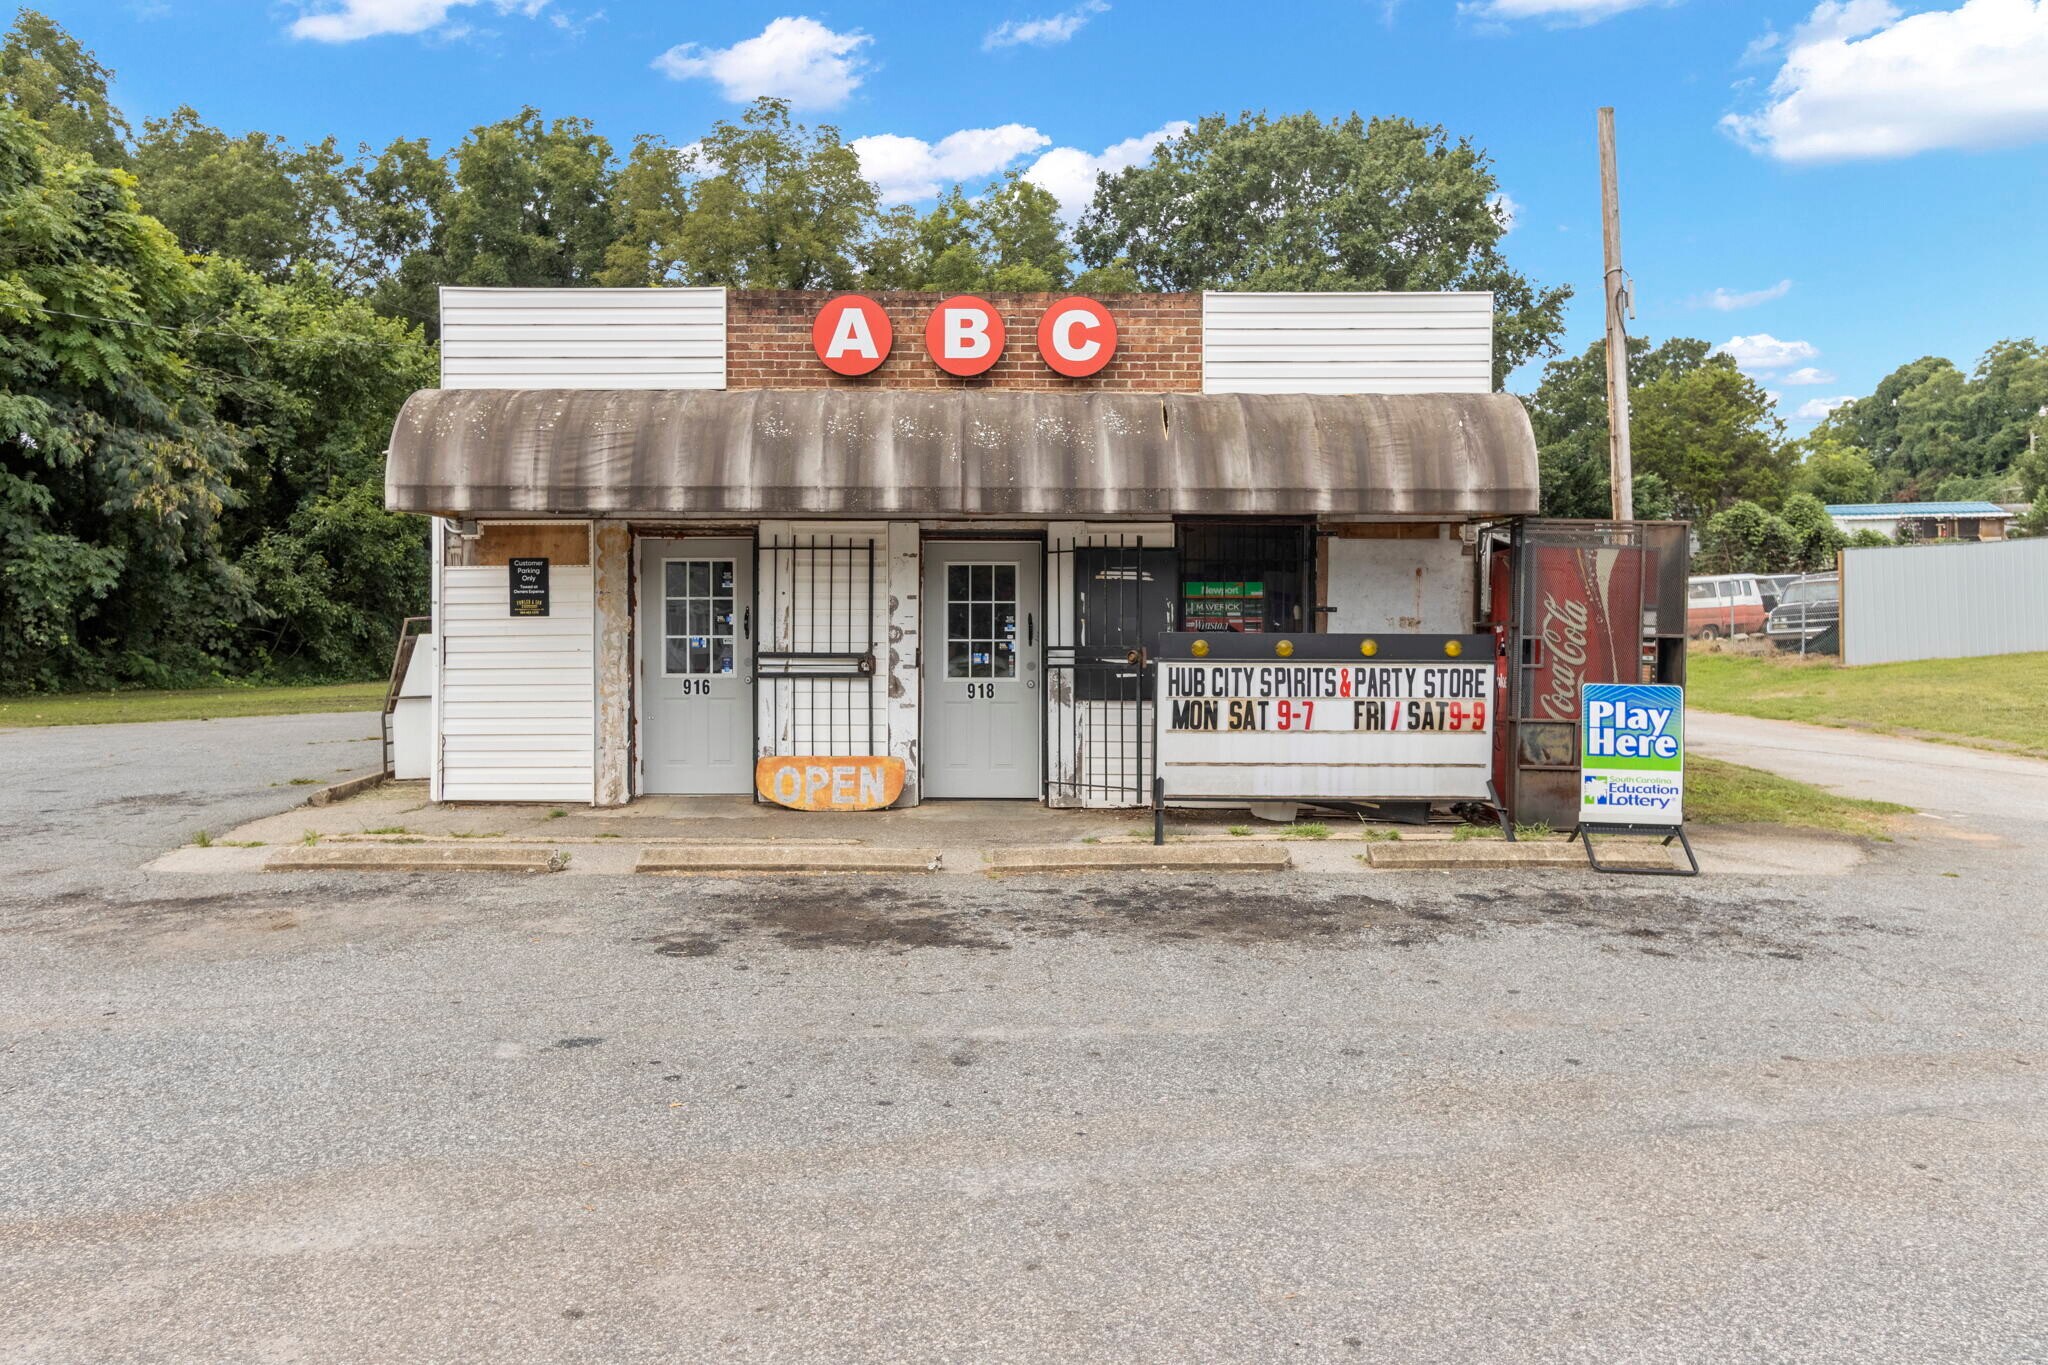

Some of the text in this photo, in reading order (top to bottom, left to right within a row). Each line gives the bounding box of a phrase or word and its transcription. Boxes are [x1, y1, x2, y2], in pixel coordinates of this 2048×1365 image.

[825, 307, 1101, 362] A B C
[517, 567, 541, 575] Parking
[1201, 586, 1239, 596] Newport
[683, 679, 710, 695] 916
[1168, 667, 1205, 697] HUB
[1212, 667, 1254, 697] CITY
[1260, 667, 1336, 697] SPIRITS
[1354, 668, 1417, 697] PARTY
[1424, 668, 1487, 697] STORE
[967, 683, 995, 699] 918
[1172, 700, 1218, 730] MON
[1229, 701, 1269, 730] SAT
[1277, 700, 1314, 730] 9-7
[1588, 700, 1672, 737] Play
[1588, 728, 1678, 758] Here
[774, 765, 885, 804] OPEN
[1609, 775, 1672, 784] South Carolina
[1608, 783, 1679, 795] Education
[1608, 793, 1670, 809] Lottery
